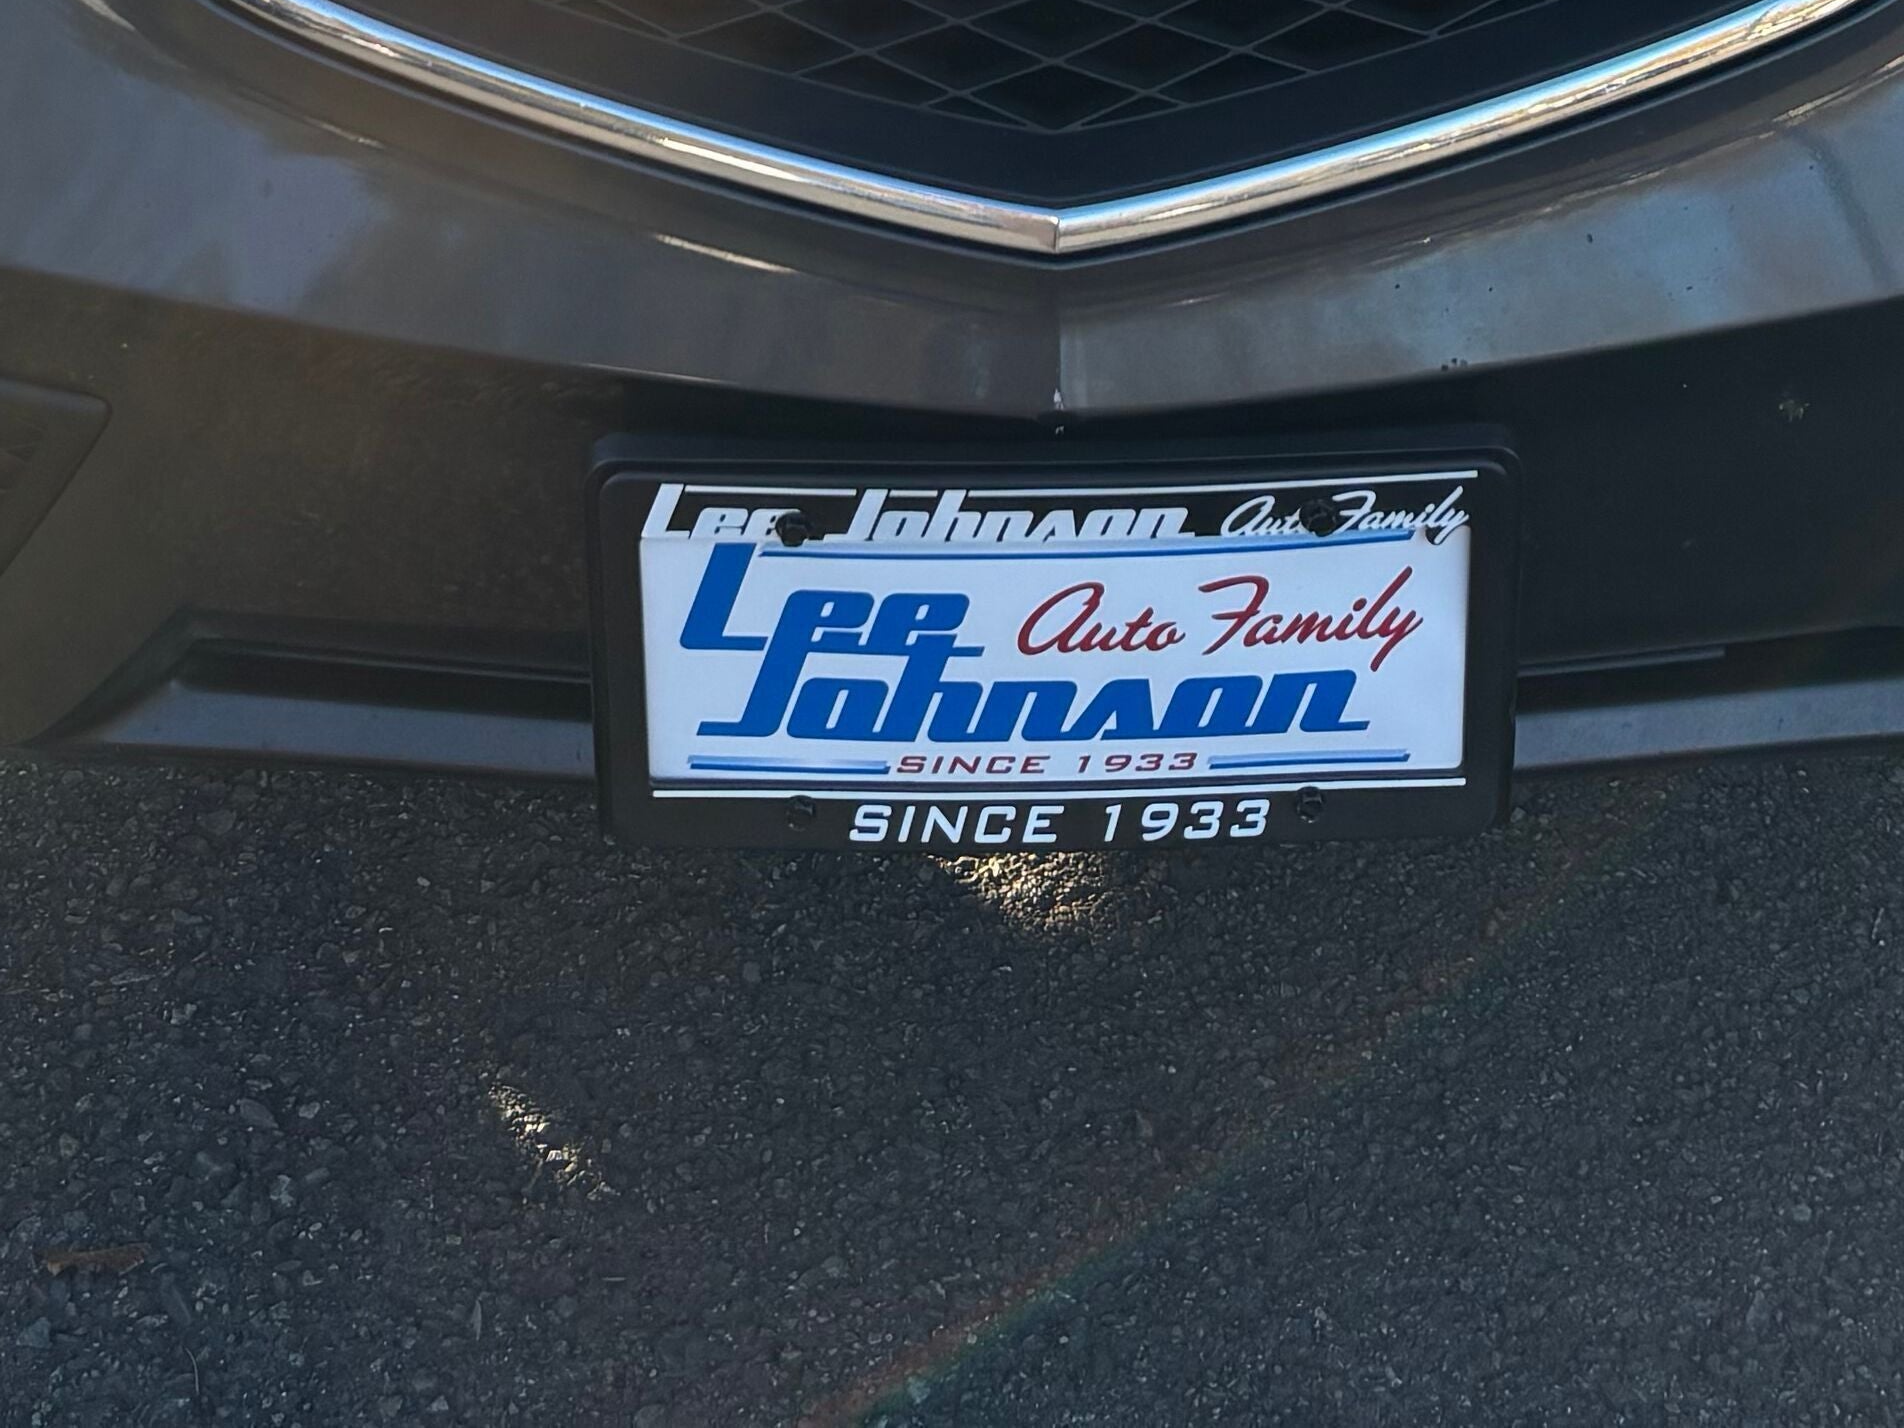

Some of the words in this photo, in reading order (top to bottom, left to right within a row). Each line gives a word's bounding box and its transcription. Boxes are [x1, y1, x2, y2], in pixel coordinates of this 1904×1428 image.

[823, 487, 1195, 541] Johnson
[1221, 494, 1312, 537] Aut
[1331, 485, 1470, 544] Family
[679, 542, 984, 657] Lee
[1017, 581, 1185, 655] Auto
[1198, 566, 1423, 671] Family
[696, 642, 1370, 741] Johnson
[897, 755, 1050, 774] SINCE
[1077, 752, 1198, 773] 1933
[848, 804, 1064, 845] SINCE
[1102, 799, 1271, 840] 1933
